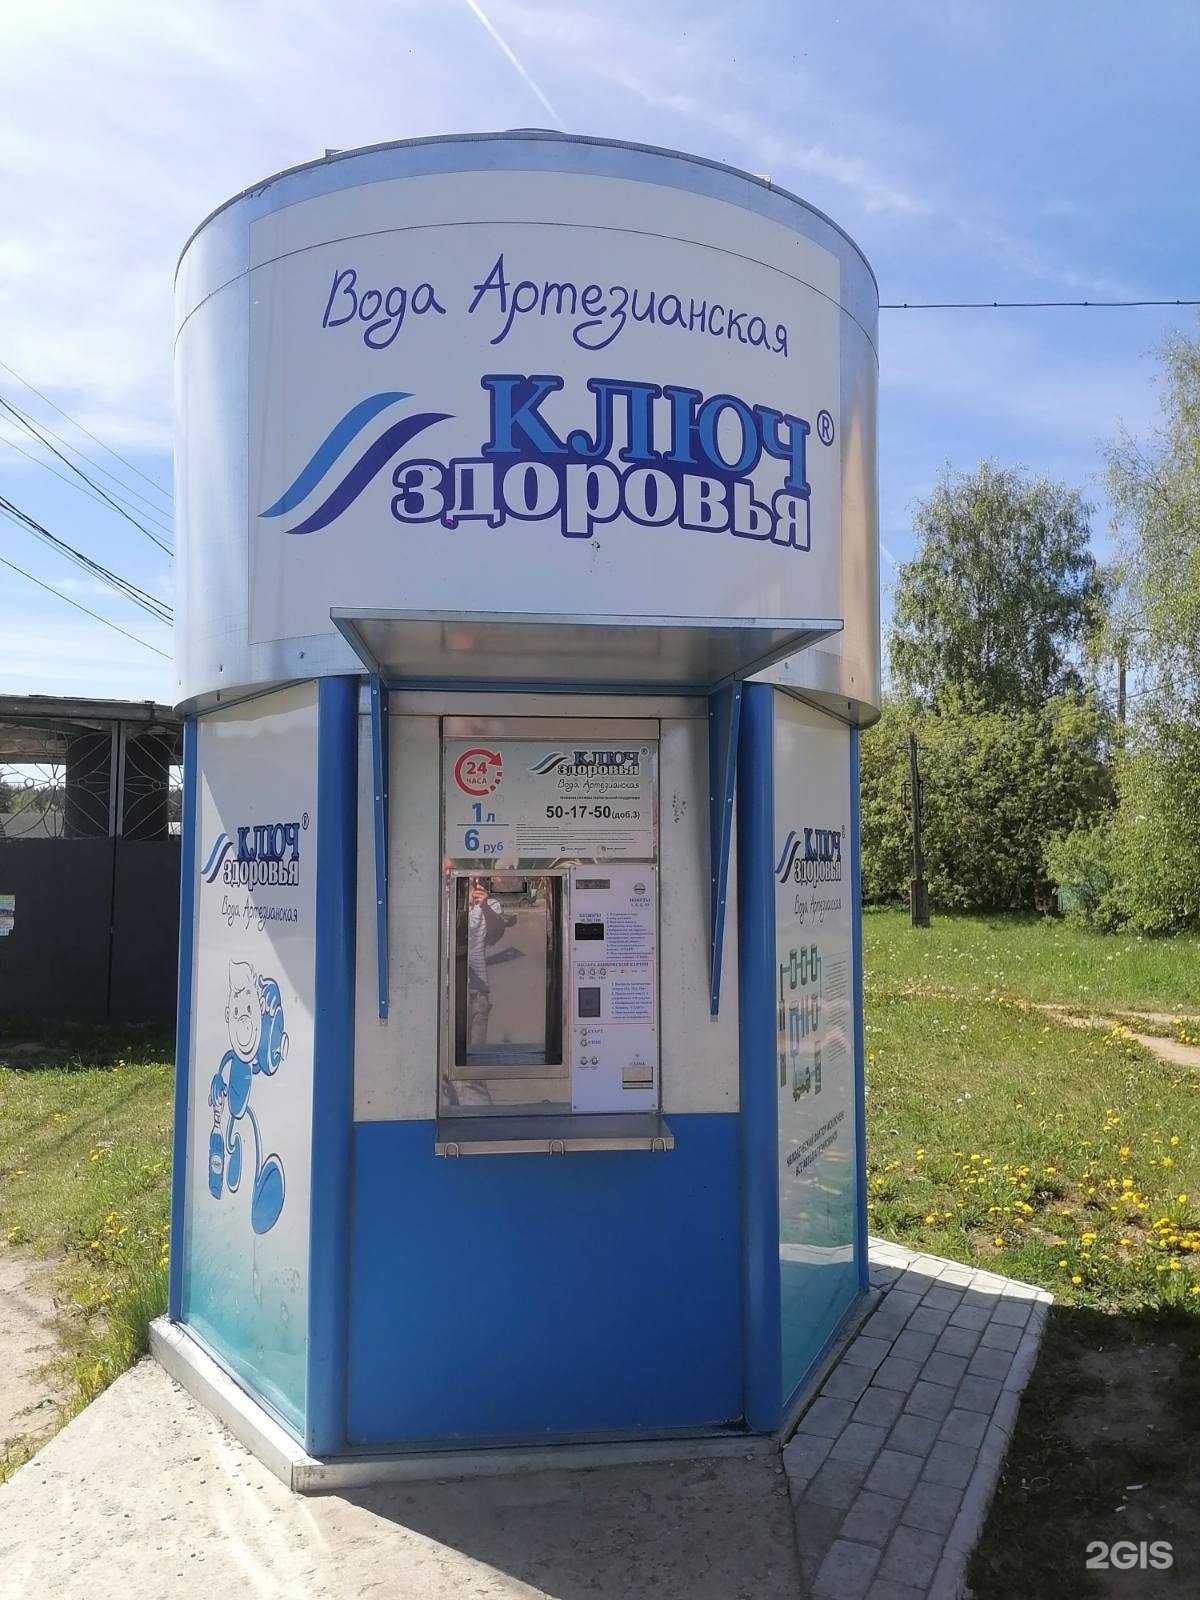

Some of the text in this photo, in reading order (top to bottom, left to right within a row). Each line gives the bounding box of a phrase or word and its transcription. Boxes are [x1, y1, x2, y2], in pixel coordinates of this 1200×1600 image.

[322, 252, 790, 358] Вода Артезианская
[481, 373, 811, 496] КЛЮЧ
[466, 761, 488, 775] 24
[557, 779, 640, 794] Вода Артезианская
[471, 803, 482, 823] 1
[464, 828, 504, 854] 6 руб
[221, 895, 298, 932] Вода Артезианская
